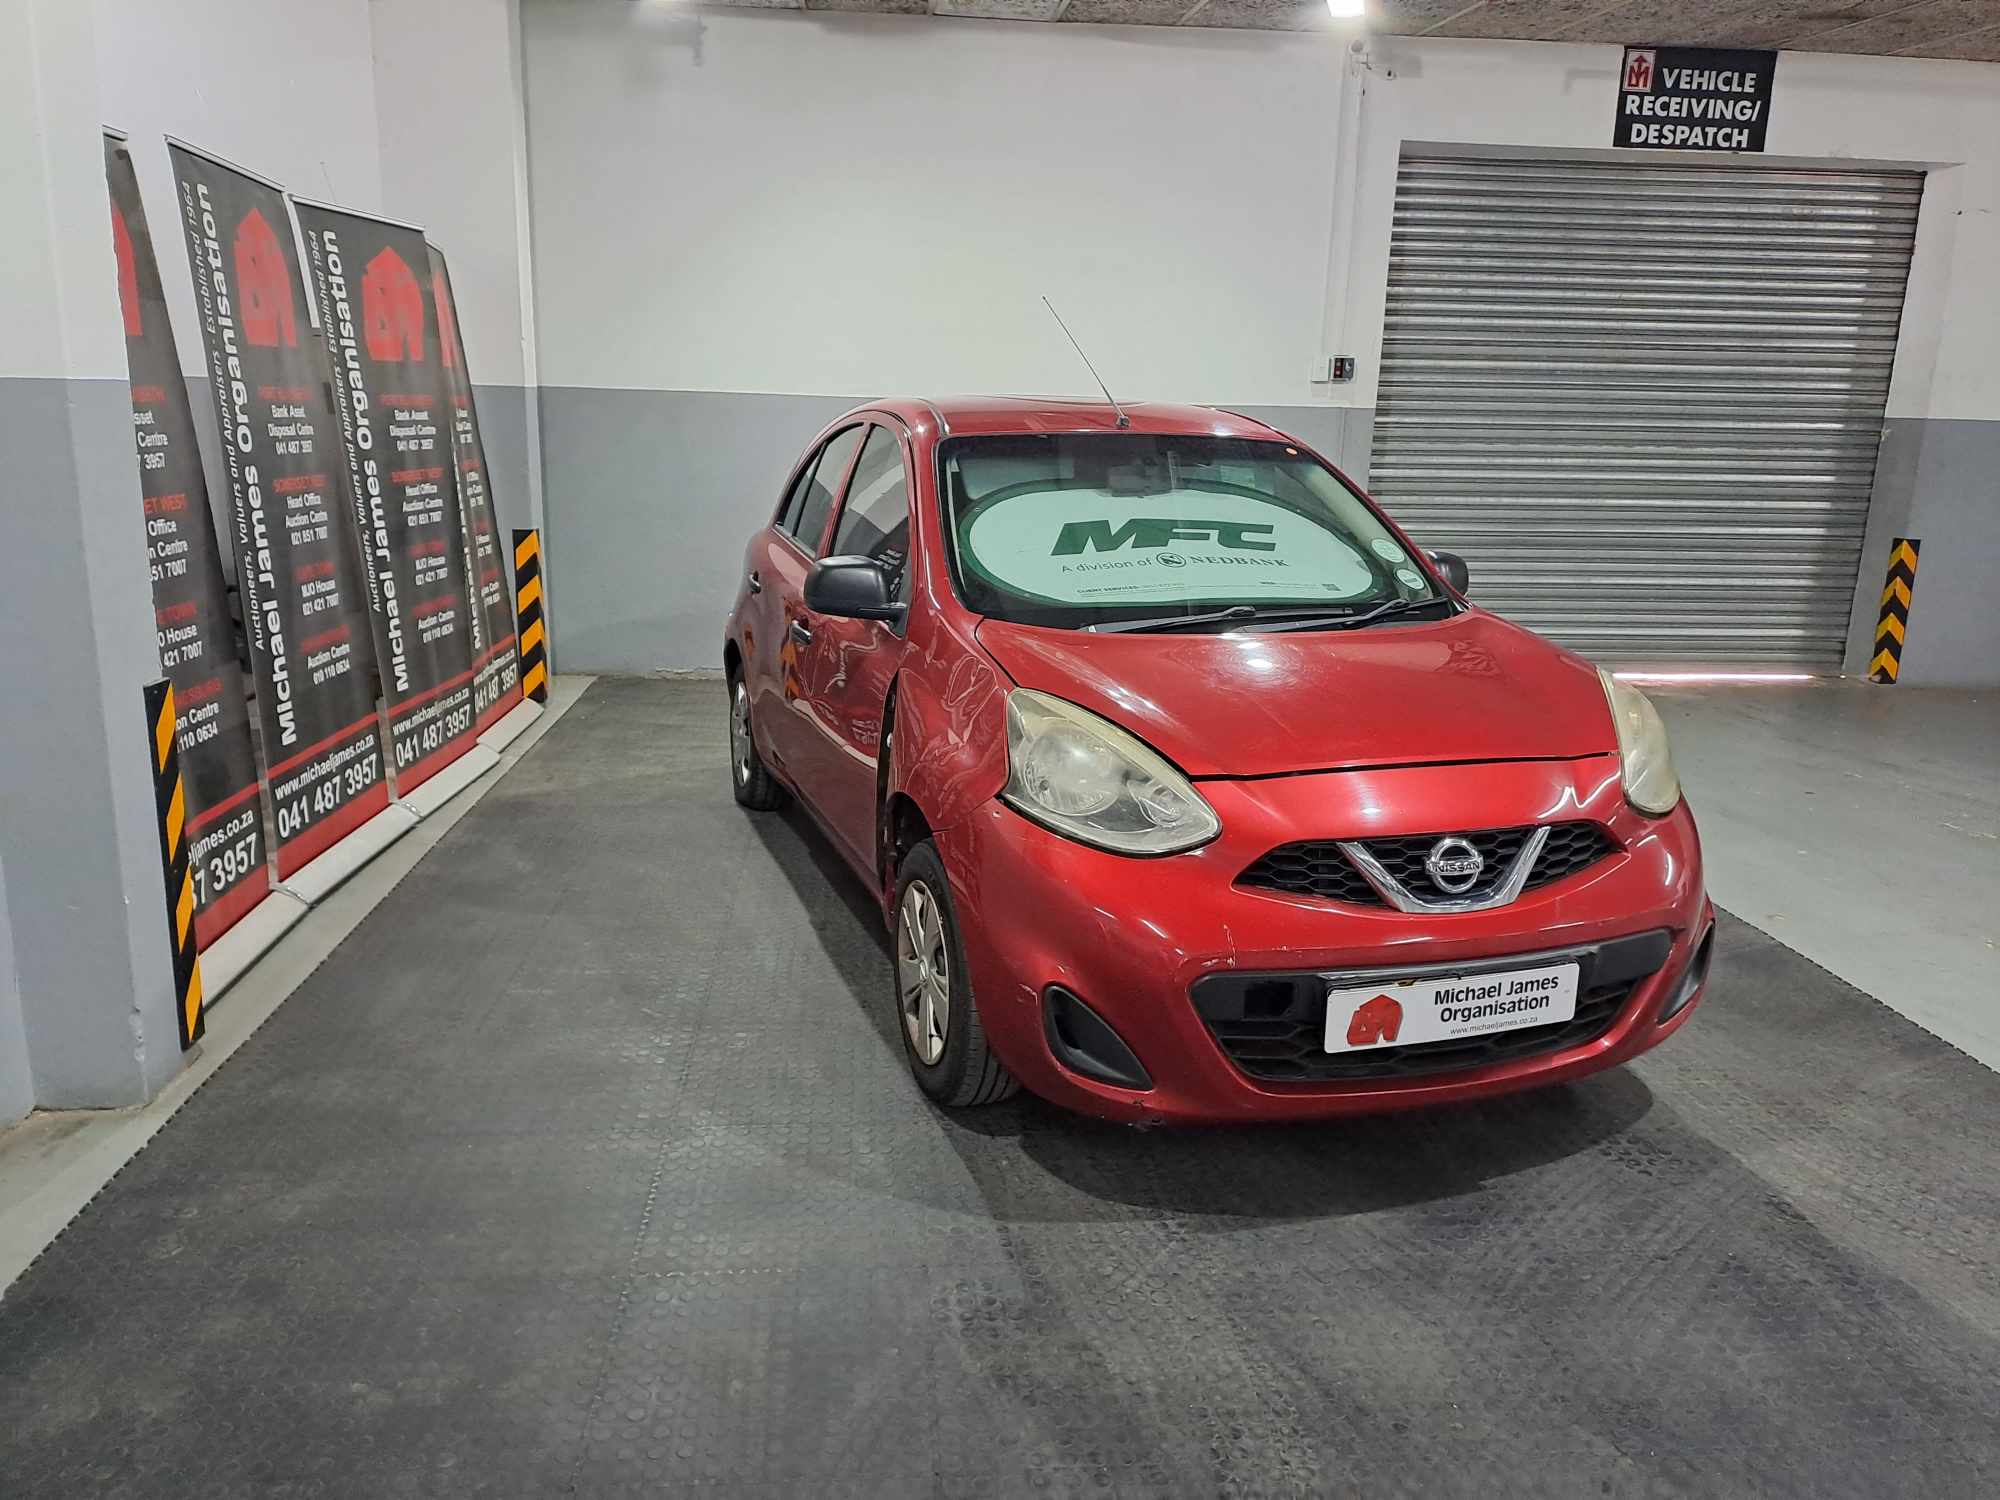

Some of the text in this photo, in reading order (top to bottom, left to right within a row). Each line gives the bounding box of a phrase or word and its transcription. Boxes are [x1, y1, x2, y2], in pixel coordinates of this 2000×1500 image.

[1662, 67, 1757, 93] VEHICLE
[1625, 94, 1761, 121] RECEIVING/
[1630, 123, 1749, 148] DESPATCH
[181, 180, 197, 227] 1964
[308, 230, 322, 267] 1964
[190, 230, 216, 334] Established
[212, 351, 234, 441] Appraisers
[134, 410, 154, 425] sset
[137, 431, 168, 447] Centre
[196, 183, 297, 746] Michael James Organisation
[225, 444, 239, 478] and
[323, 230, 409, 692] Michael James Organisation
[346, 443, 359, 471] and
[148, 519, 177, 536] Office
[233, 483, 249, 544] Valuers
[158, 539, 188, 558] Centre
[1050, 518, 1277, 556] MFC
[150, 558, 187, 582] 51 7007
[1061, 555, 1289, 573] A division of NEDBANK
[244, 550, 264, 650] Auctioneers,
[167, 624, 197, 644] House
[163, 641, 203, 668] 421 7007
[500, 662, 517, 691] 3957
[188, 701, 219, 724] Centre
[392, 688, 470, 736] www.michaeljames.co.za
[179, 731, 195, 753] 110
[197, 721, 218, 744] 0634
[395, 703, 471, 767] 041 487 3957
[275, 734, 375, 800] www.michaeljames.co.za
[278, 753, 377, 838] 041 487 3957
[210, 832, 257, 891] 3957
[1434, 862, 1480, 873] NISSAN
[1434, 975, 1559, 1006] Michael James
[1440, 994, 1550, 1024] Organisation
[1449, 1015, 1538, 1036] www.michaeljames.co.za
